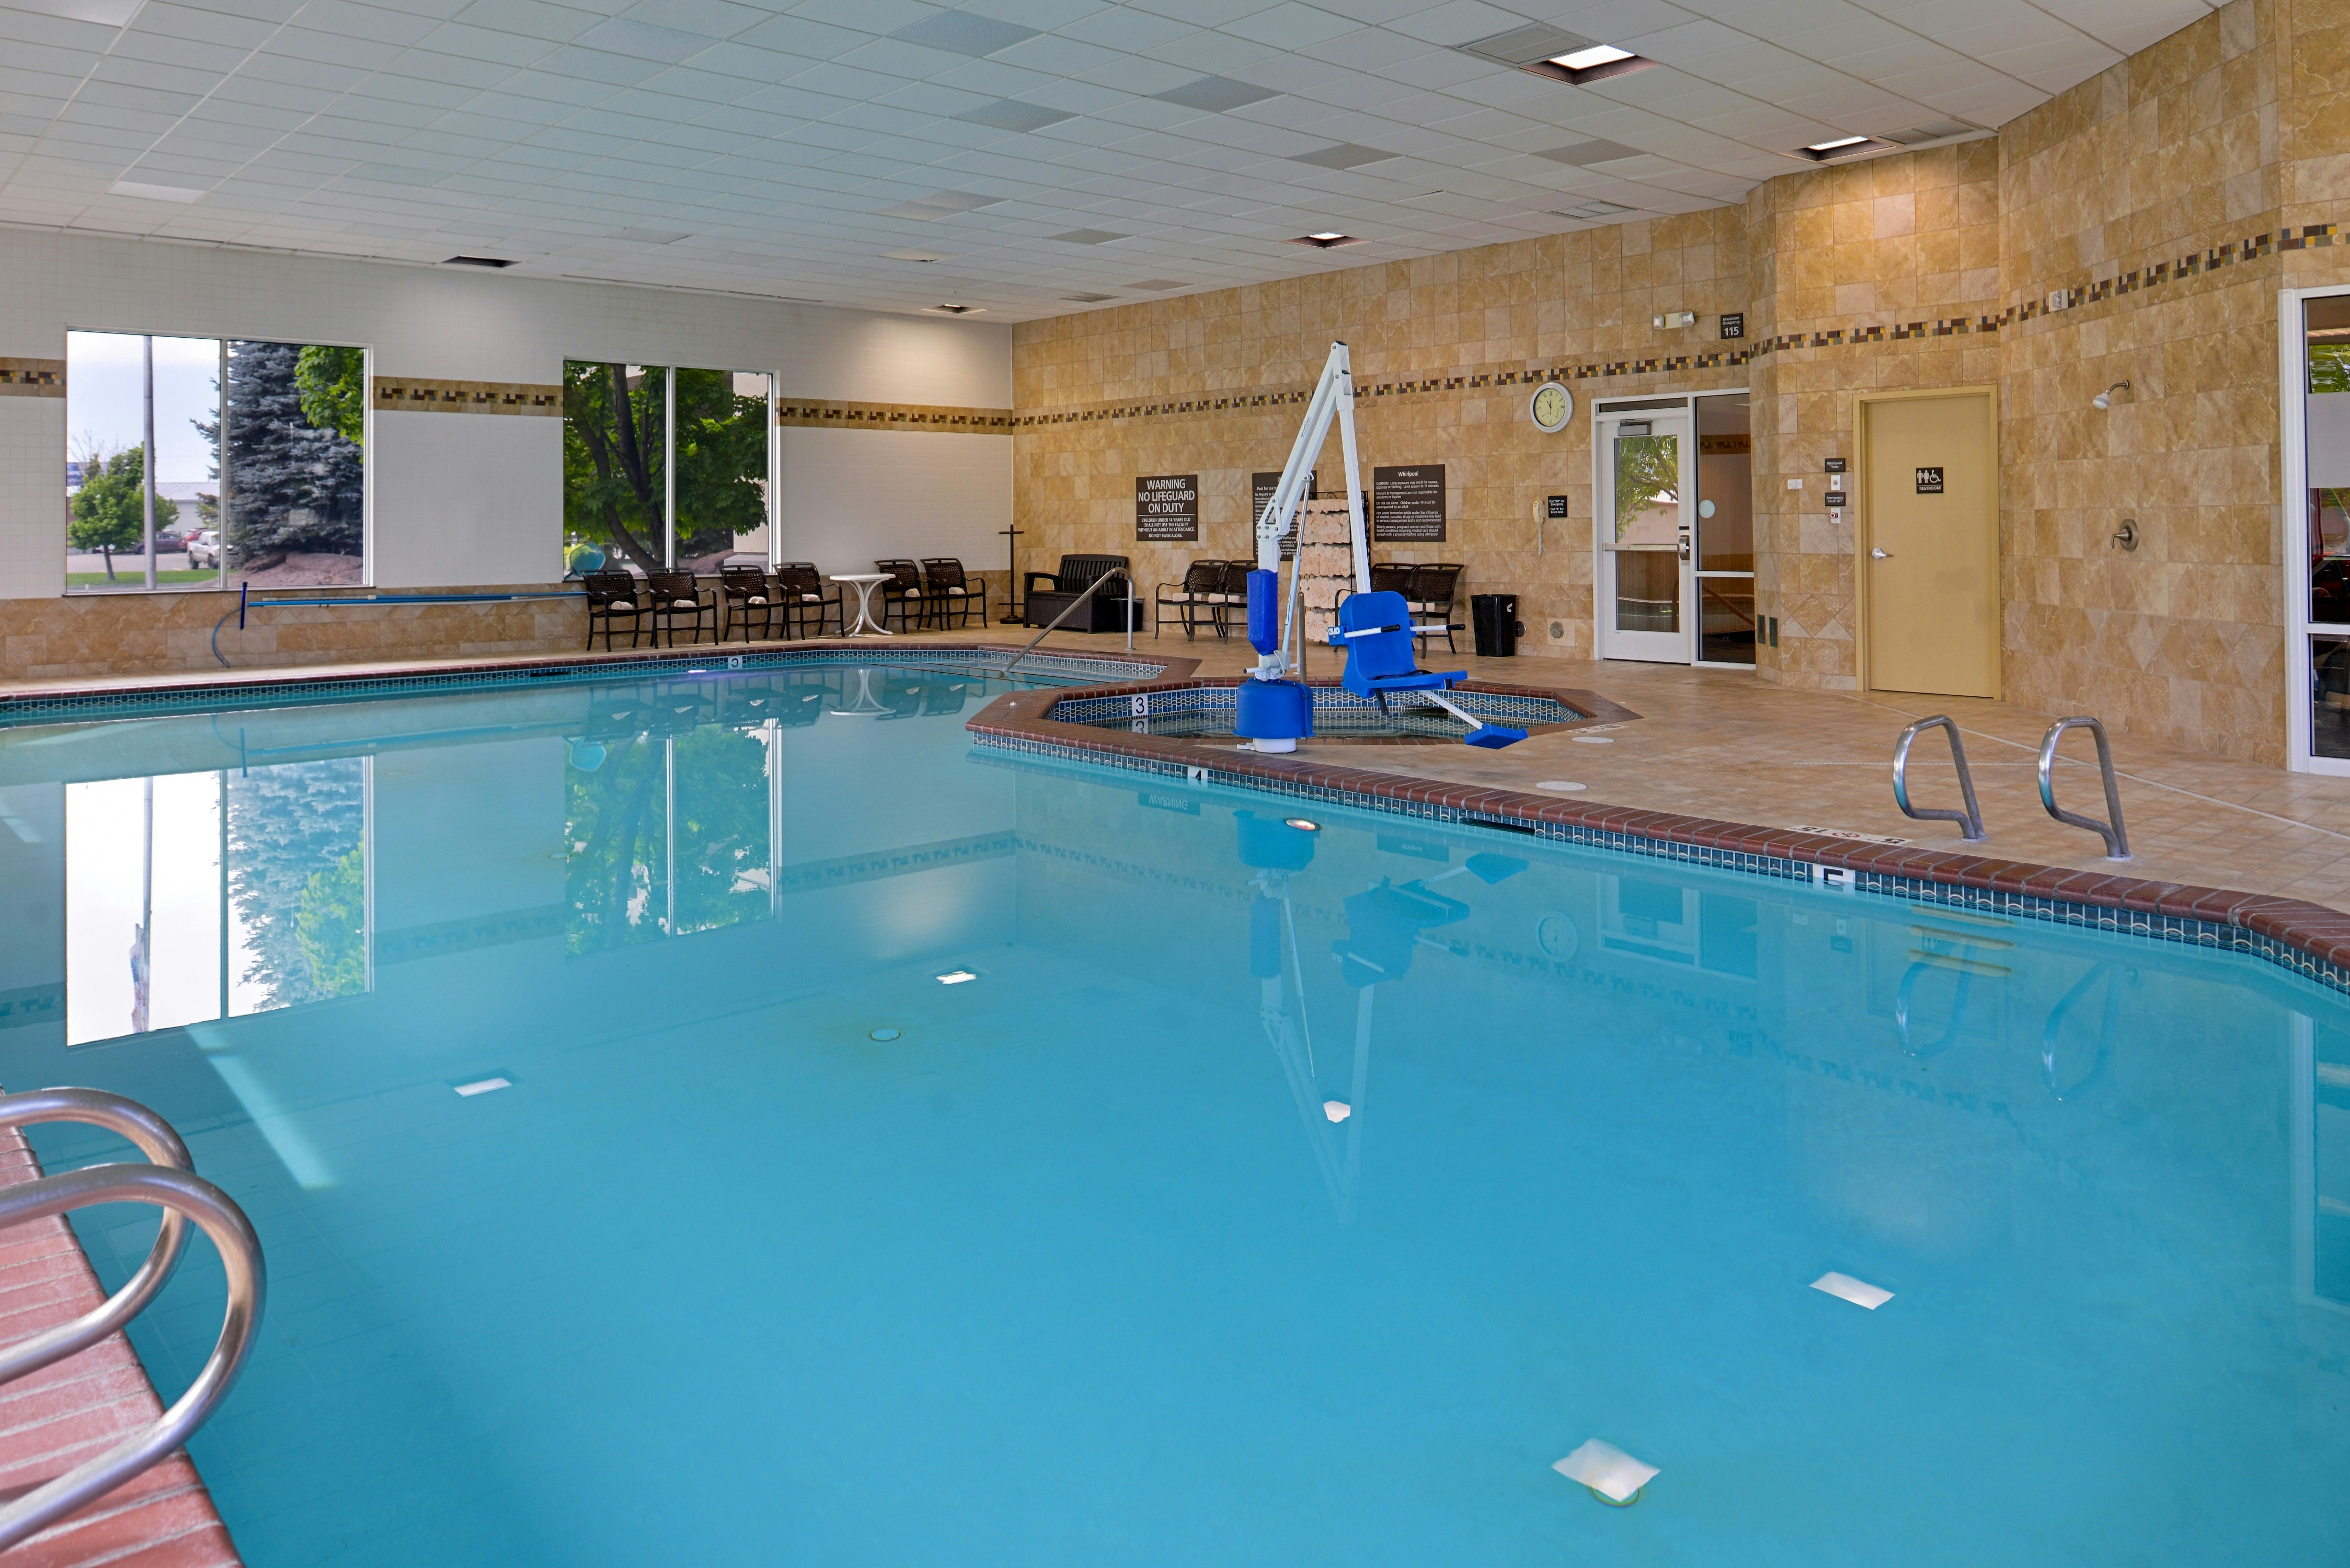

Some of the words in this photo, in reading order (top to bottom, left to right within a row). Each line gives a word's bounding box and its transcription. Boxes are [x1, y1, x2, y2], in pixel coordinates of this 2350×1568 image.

[1724, 327, 1739, 336] 115
[1147, 479, 1185, 490] WARNING
[1138, 492, 1150, 502] NO
[1152, 490, 1195, 501] LIFEGUARD
[1148, 503, 1160, 513] ON
[1162, 503, 1184, 513] DUTY
[1136, 697, 1145, 714] 3
